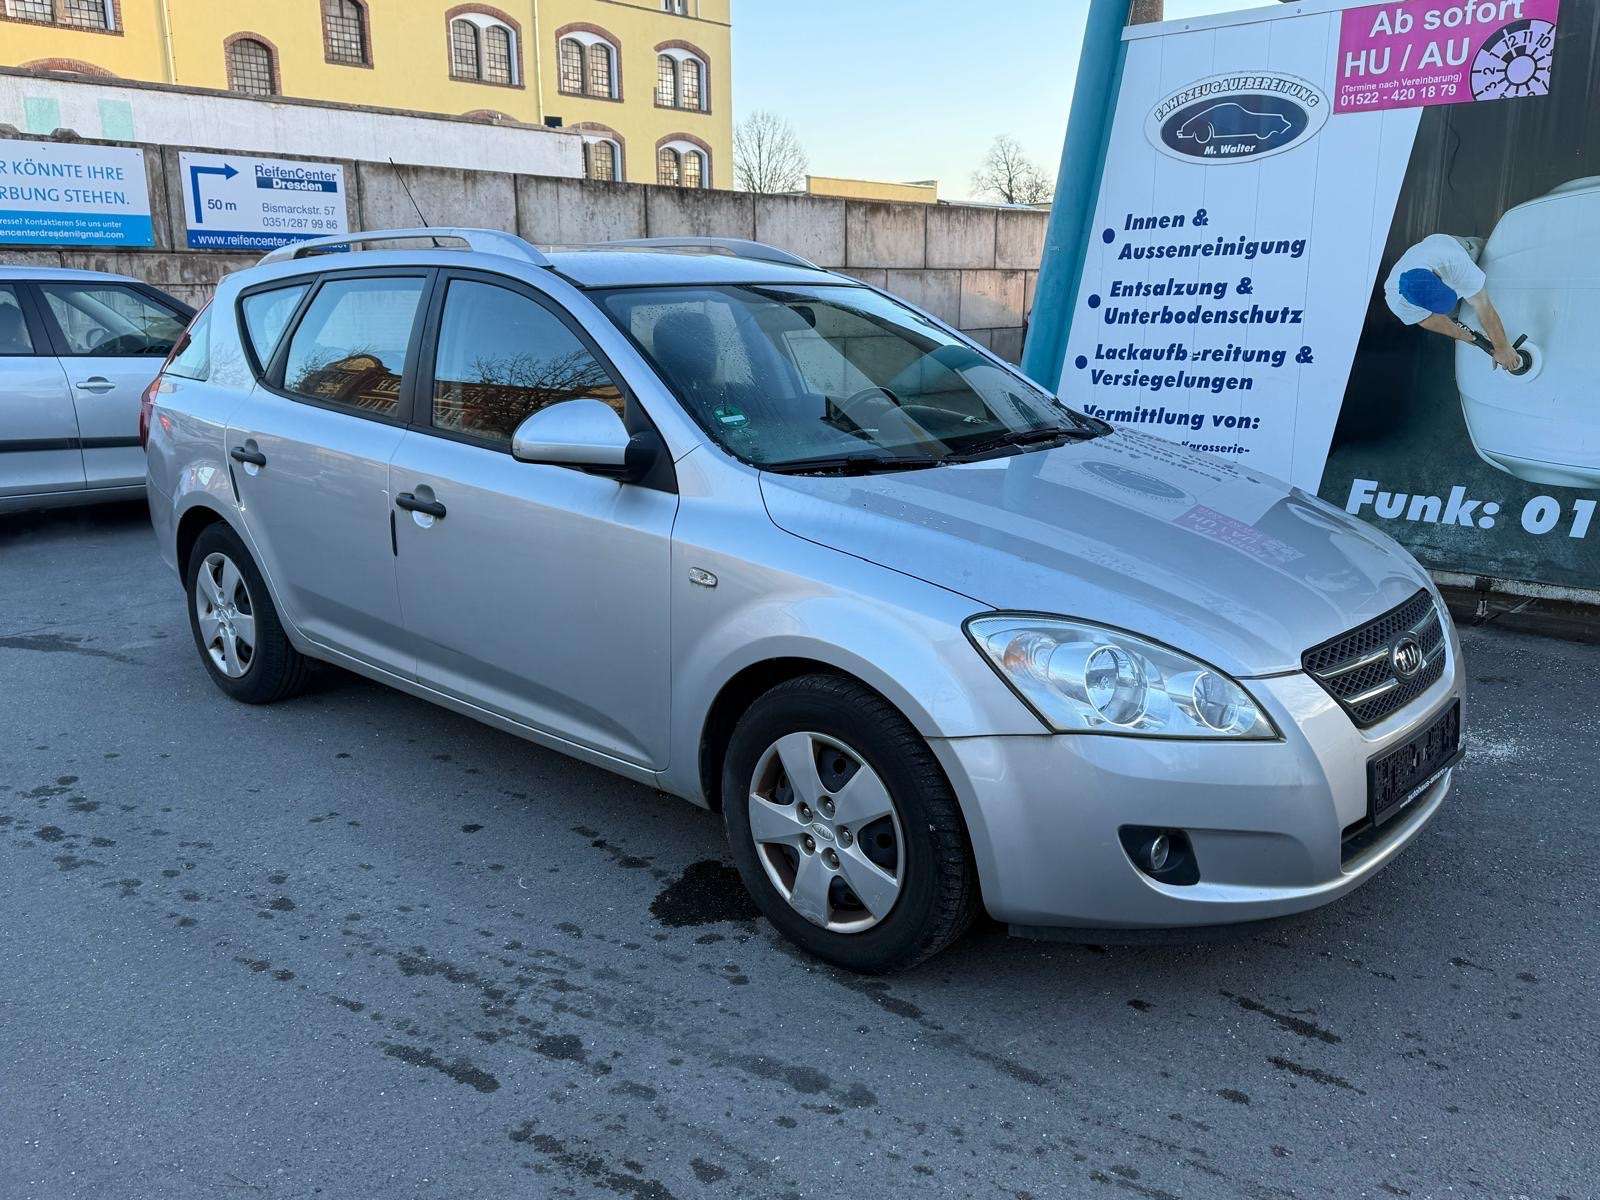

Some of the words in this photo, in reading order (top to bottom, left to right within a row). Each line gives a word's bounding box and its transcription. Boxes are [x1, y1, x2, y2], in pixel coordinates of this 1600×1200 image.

[1369, 8, 1413, 37] Ab
[1423, 0, 1524, 31] sofort
[1502, 35, 1519, 49] 12
[1523, 31, 1533, 43] 11
[1536, 33, 1551, 48] 10
[1344, 47, 1391, 78] HU
[1399, 44, 1412, 72] /
[1418, 37, 1470, 69] AU
[1483, 67, 1496, 75] 2
[1341, 83, 1377, 94] (Termine
[1379, 80, 1399, 89] nach
[1402, 73, 1462, 87] Vereinbarung)
[1485, 81, 1497, 91] 3
[1154, 76, 1320, 122] FAHRZEUGAUFBEREITUNG
[1340, 91, 1379, 106] 01522
[1391, 88, 1416, 101] 420
[1421, 85, 1436, 98] 18
[1440, 83, 1457, 96] 79
[1204, 145, 1217, 155] M.
[1220, 143, 1256, 154] Walter
[12, 158, 82, 178] KÖNNTE
[88, 165, 125, 180] IHRE
[255, 165, 337, 181] ReifenCenter
[272, 178, 323, 191] Dresden
[64, 189, 130, 205] STEHEN.
[207, 199, 222, 210] 50
[225, 201, 237, 210] m
[262, 203, 322, 215] Bismarckstr.
[324, 206, 336, 215] 57
[25, 218, 73, 227] Kontaktieren
[75, 219, 86, 227] Sie
[262, 217, 308, 228] 0351/287
[311, 219, 323, 228] 99
[326, 220, 338, 229] 86
[1124, 213, 1185, 231] Innen
[1191, 208, 1209, 226] &
[1117, 235, 1306, 260] Aussenreinigung
[1109, 278, 1228, 300] Entsalzung
[1235, 276, 1253, 295] &
[1104, 305, 1304, 325] Unterbodenschutz
[1295, 345, 1315, 364] &
[1090, 368, 1253, 393] Versiegelungen
[1083, 404, 1205, 430] Vermittlung
[1212, 414, 1261, 430] von:
[1345, 478, 1500, 529] Funk:
[1521, 495, 1597, 539] 01
